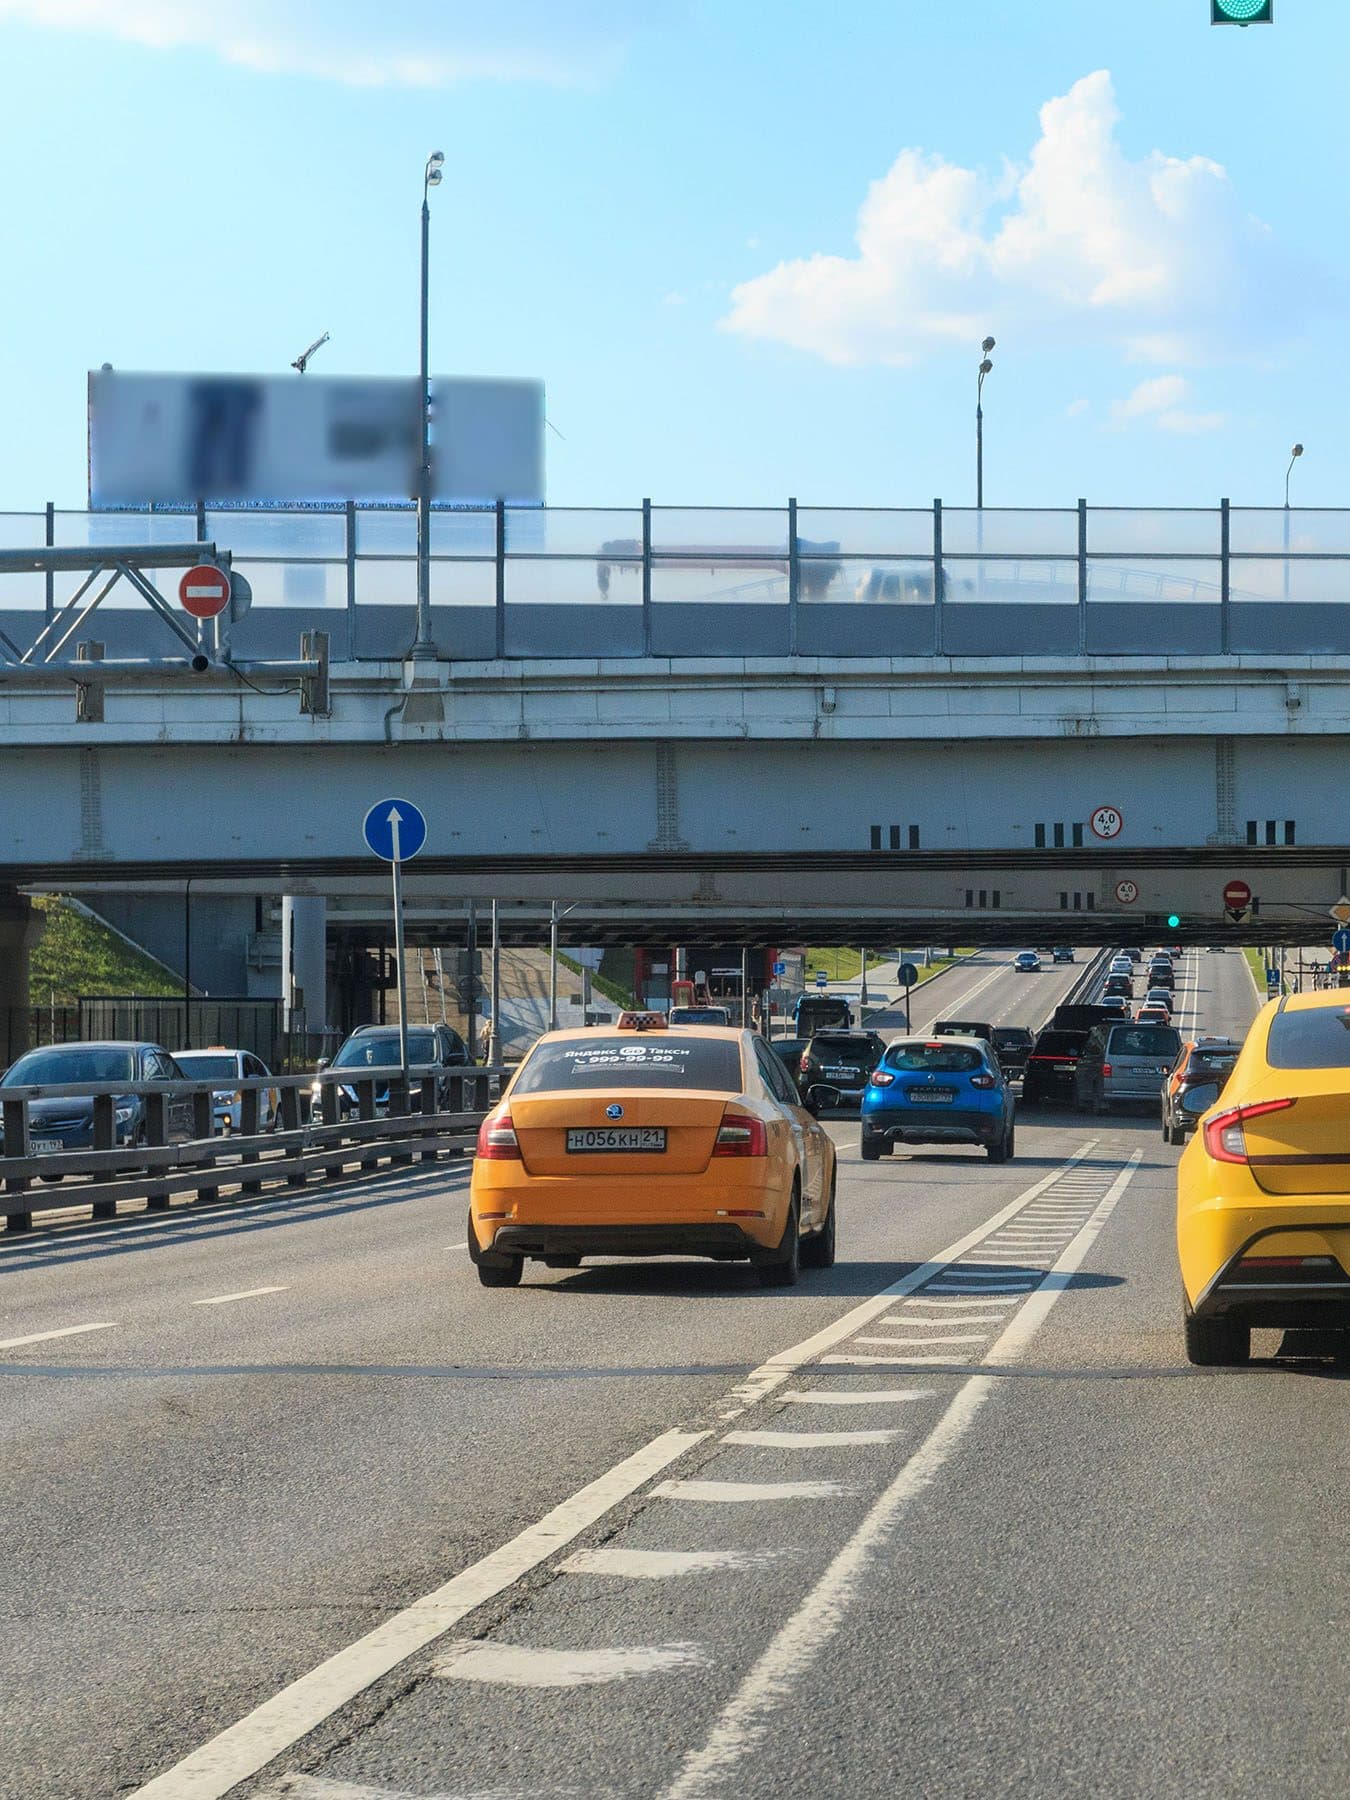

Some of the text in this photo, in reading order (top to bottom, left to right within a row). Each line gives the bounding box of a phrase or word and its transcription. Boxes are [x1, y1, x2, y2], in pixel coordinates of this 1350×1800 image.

[564, 1048, 617, 1058] Яндекс
[648, 1047, 690, 1055] Такси
[588, 1055, 673, 1064] 999-99-99
[643, 1130, 659, 1142] 21
